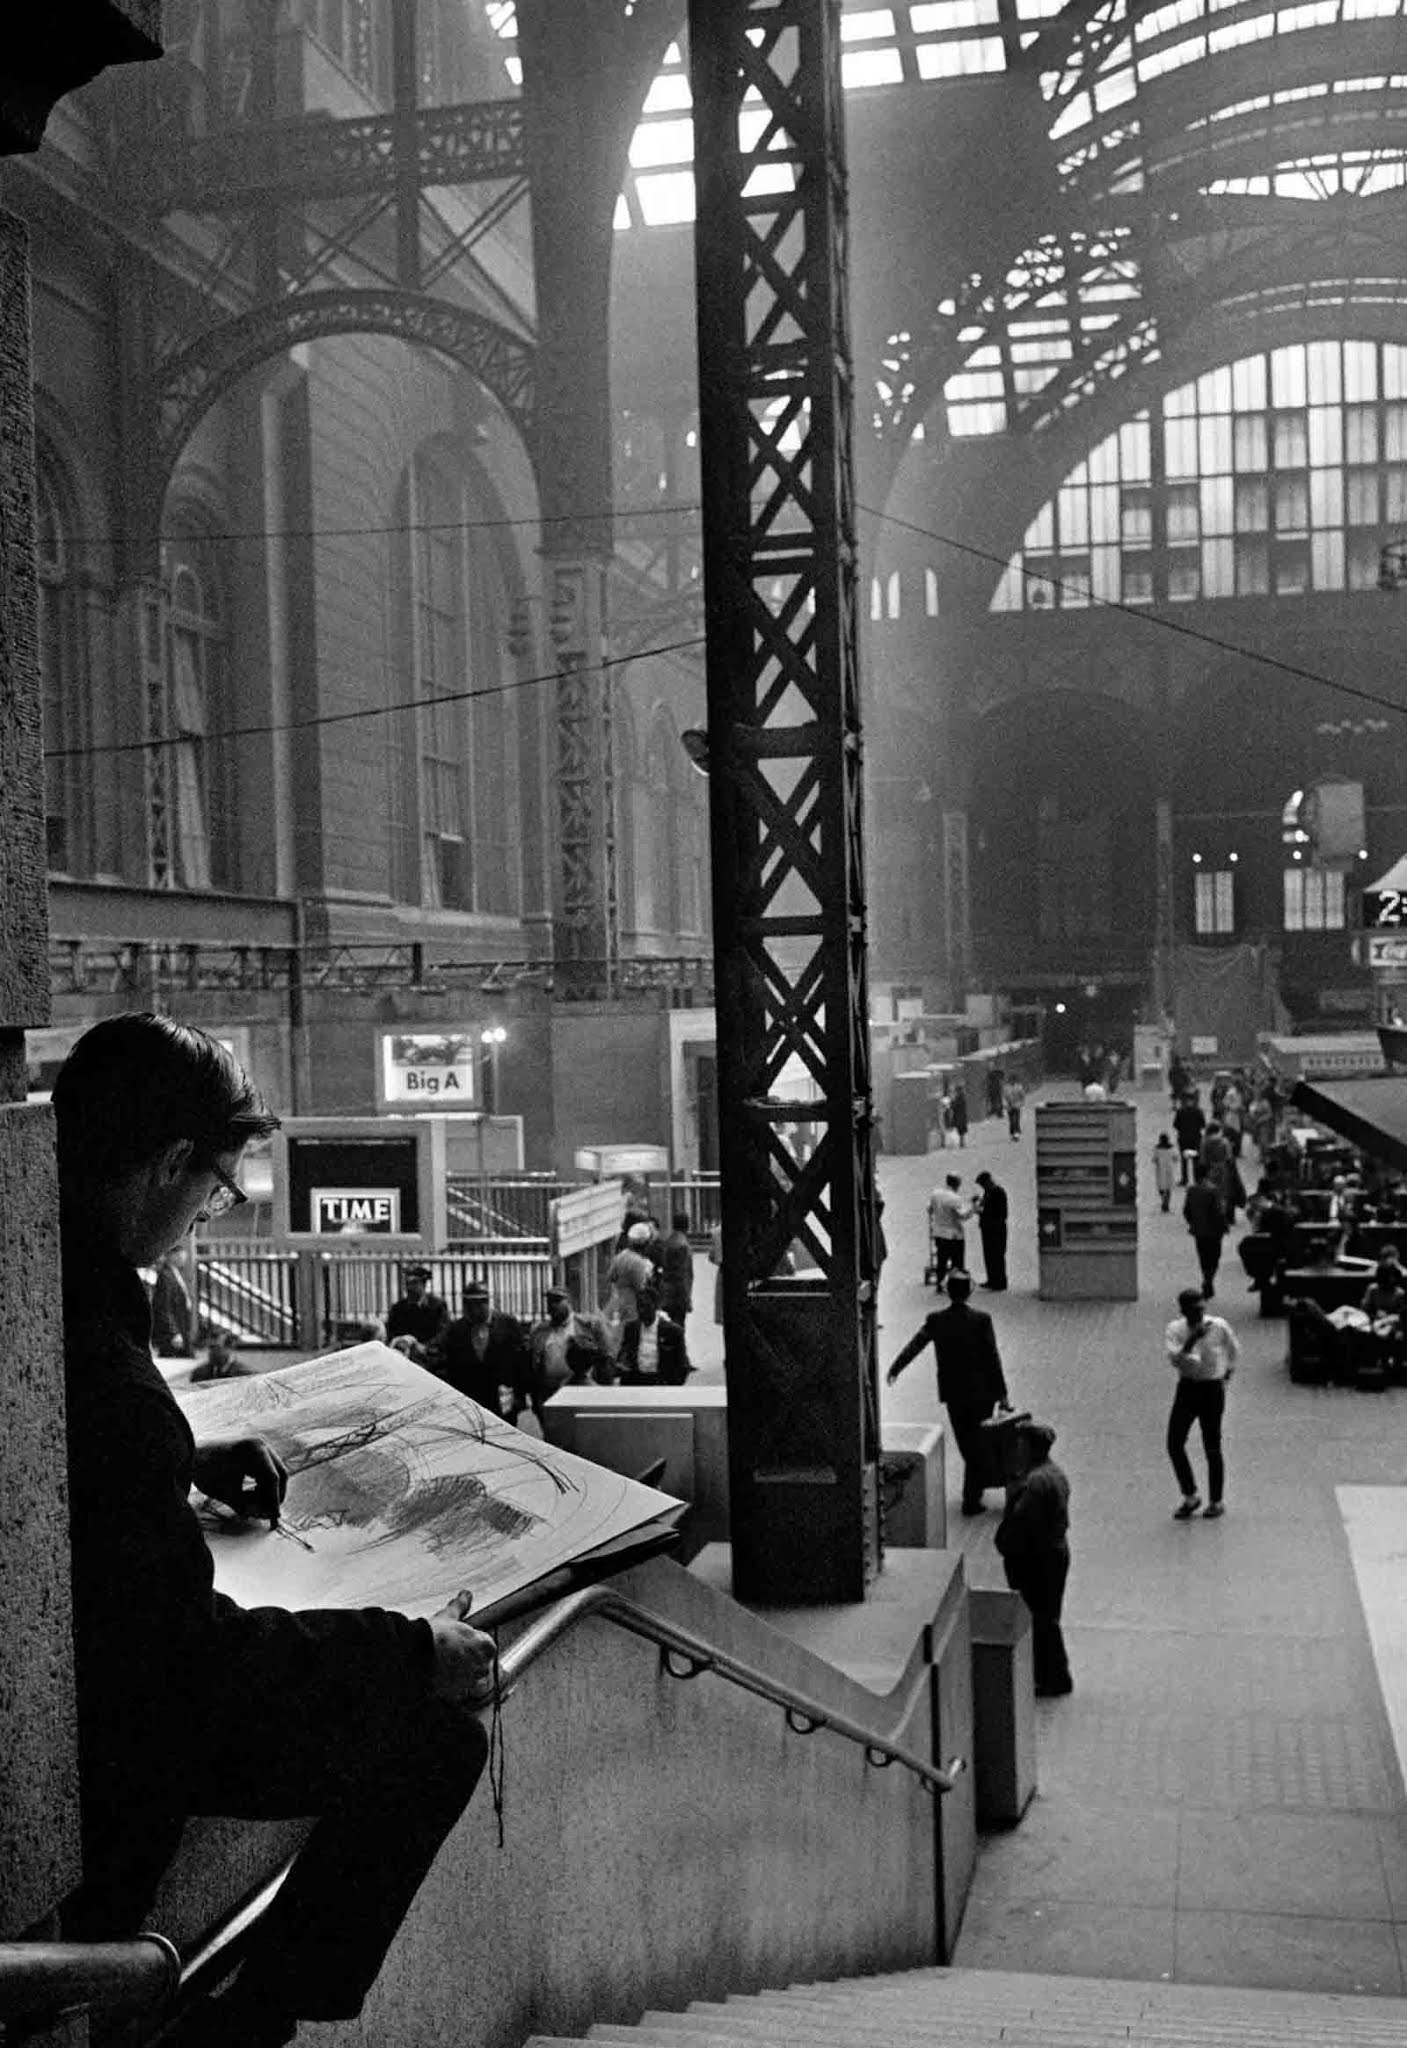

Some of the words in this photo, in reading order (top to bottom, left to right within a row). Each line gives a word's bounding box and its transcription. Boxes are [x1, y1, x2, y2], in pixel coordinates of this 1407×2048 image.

[407, 1070, 440, 1095] Big
[444, 1071, 460, 1090] A
[321, 1199, 389, 1220] TIME
